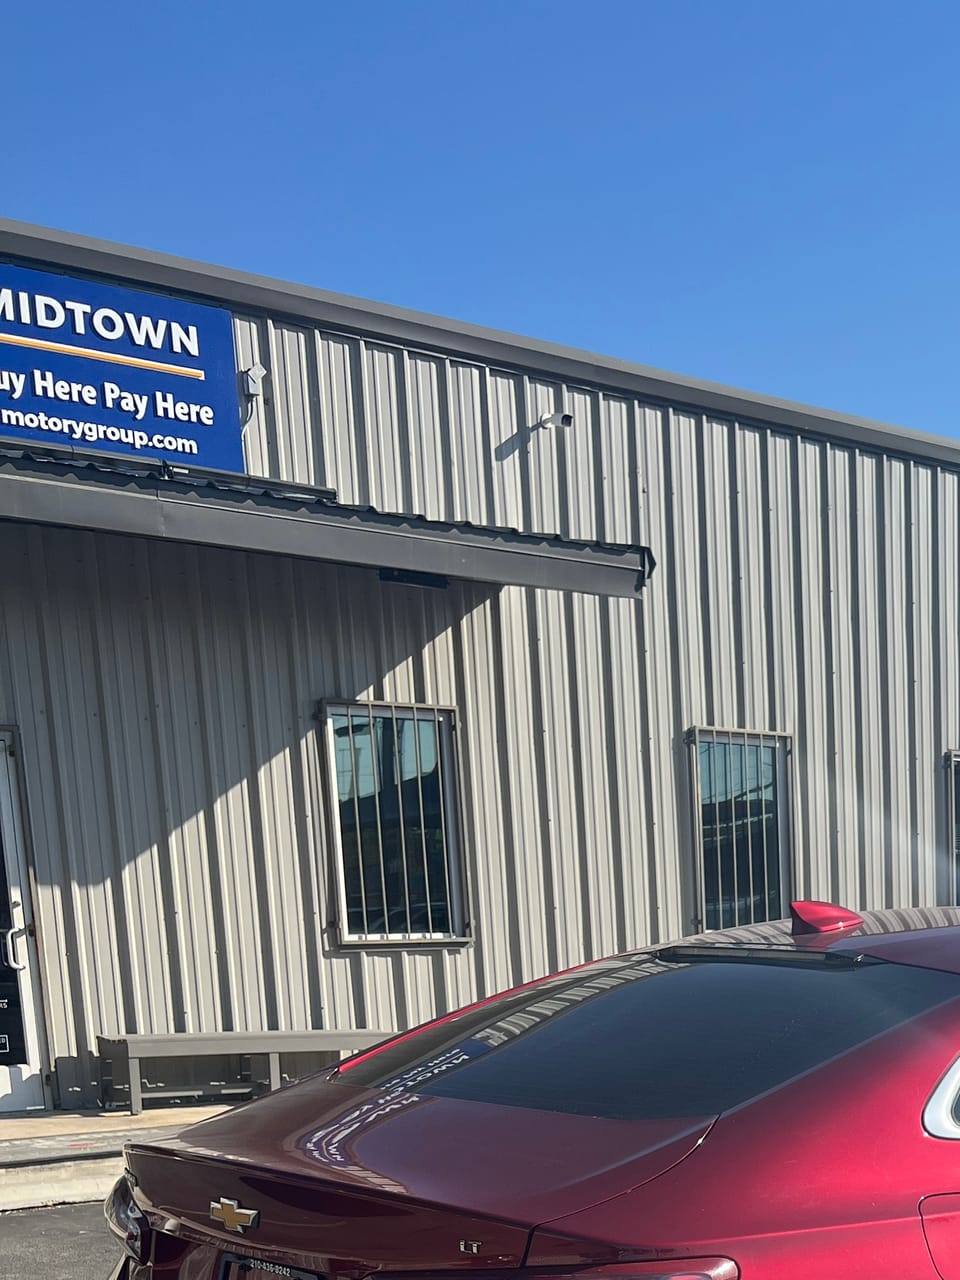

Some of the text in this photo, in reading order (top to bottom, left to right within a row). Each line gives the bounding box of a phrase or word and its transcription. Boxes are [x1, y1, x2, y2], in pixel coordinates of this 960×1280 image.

[0, 288, 200, 357] MIDTOWN
[33, 369, 97, 405] Here
[103, 381, 148, 420] Pay
[155, 391, 214, 425] Here
[1, 409, 198, 454] motorygroup.com
[460, 1240, 482, 1254] LT
